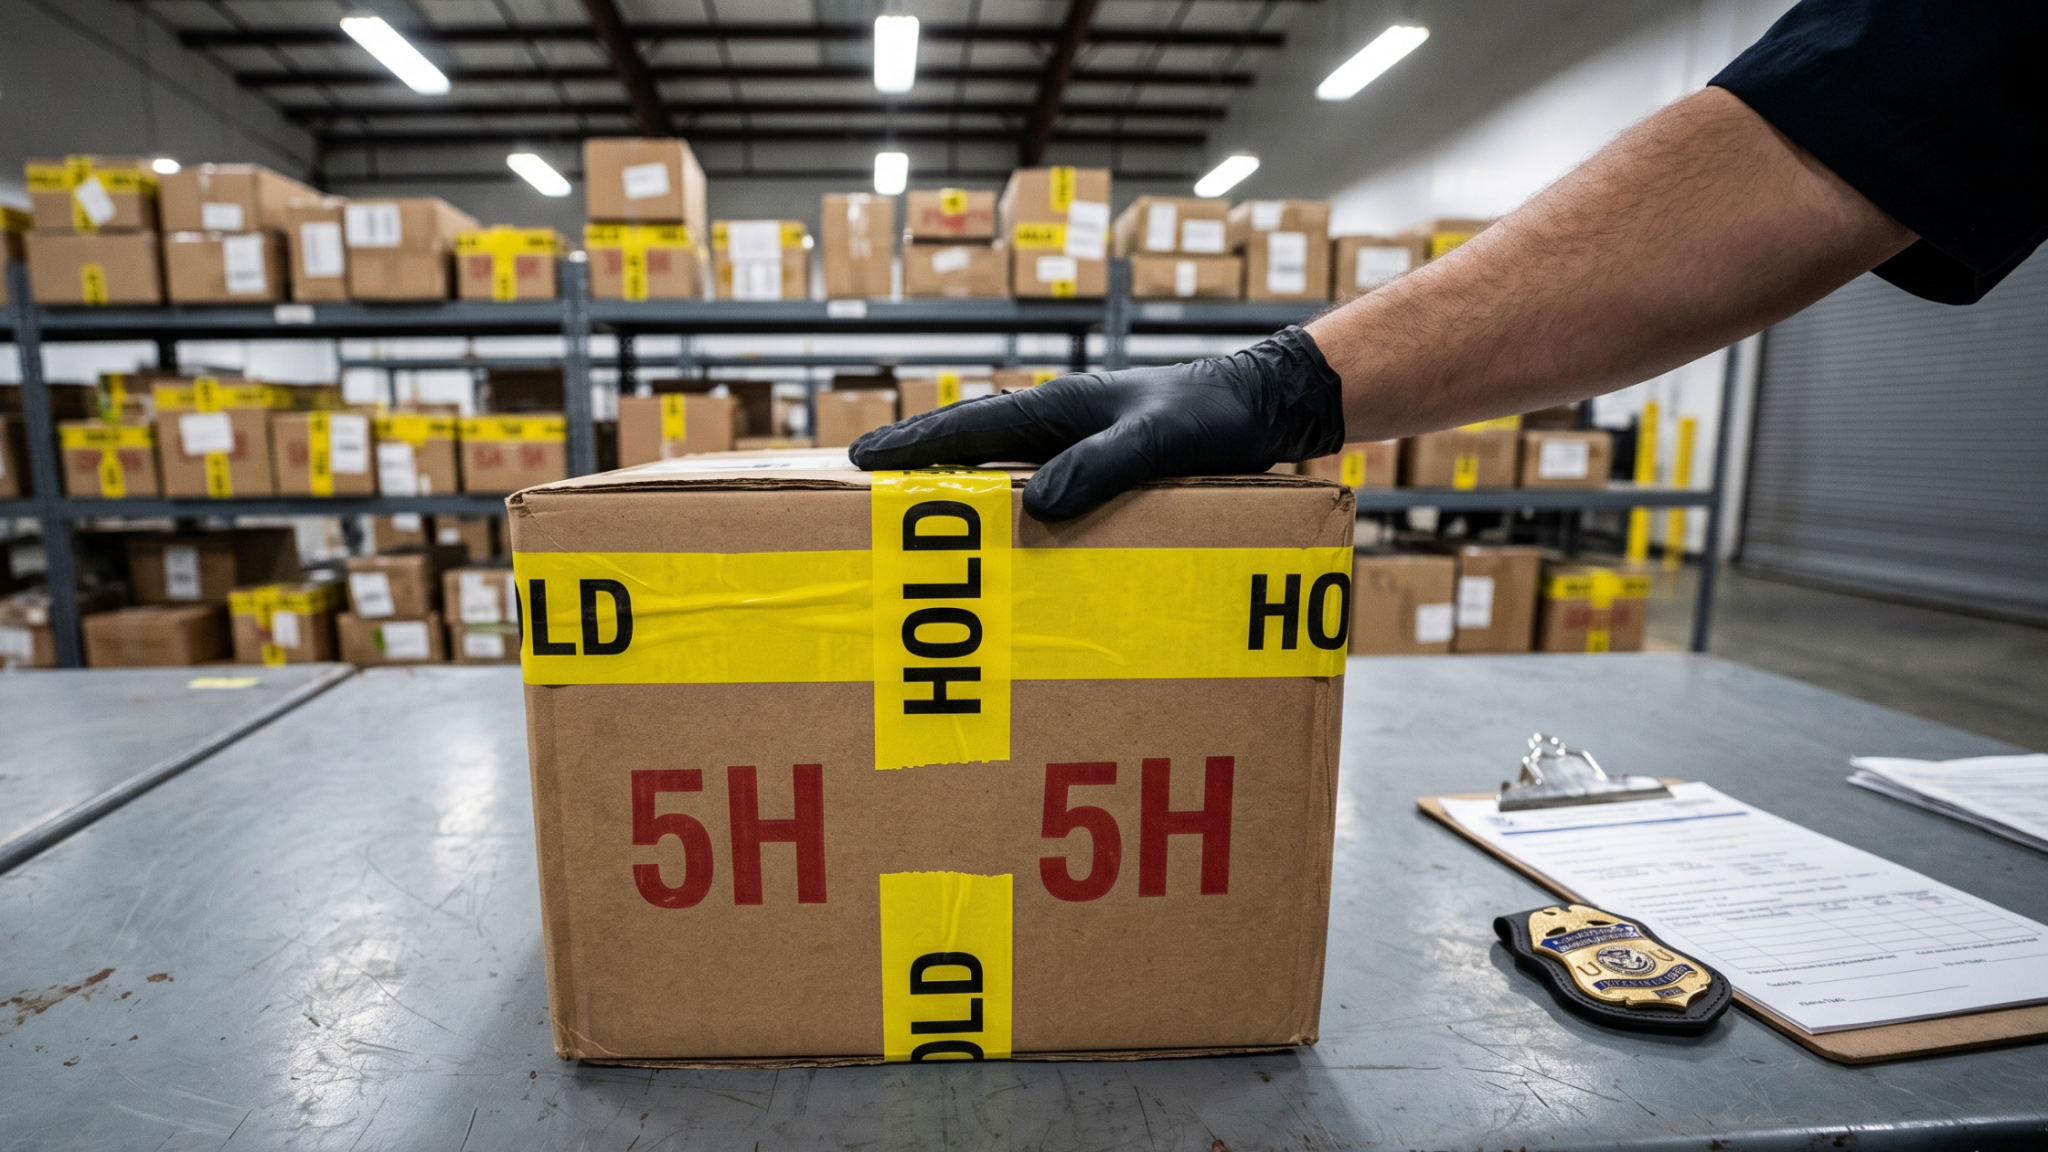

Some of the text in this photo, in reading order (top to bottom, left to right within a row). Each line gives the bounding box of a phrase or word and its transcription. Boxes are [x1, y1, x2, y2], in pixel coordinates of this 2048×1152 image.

[516, 578, 634, 656] LD
[902, 500, 982, 715] HOLD
[1247, 571, 1351, 651] HO
[631, 763, 827, 908] 5H
[1039, 756, 1235, 902] 5H
